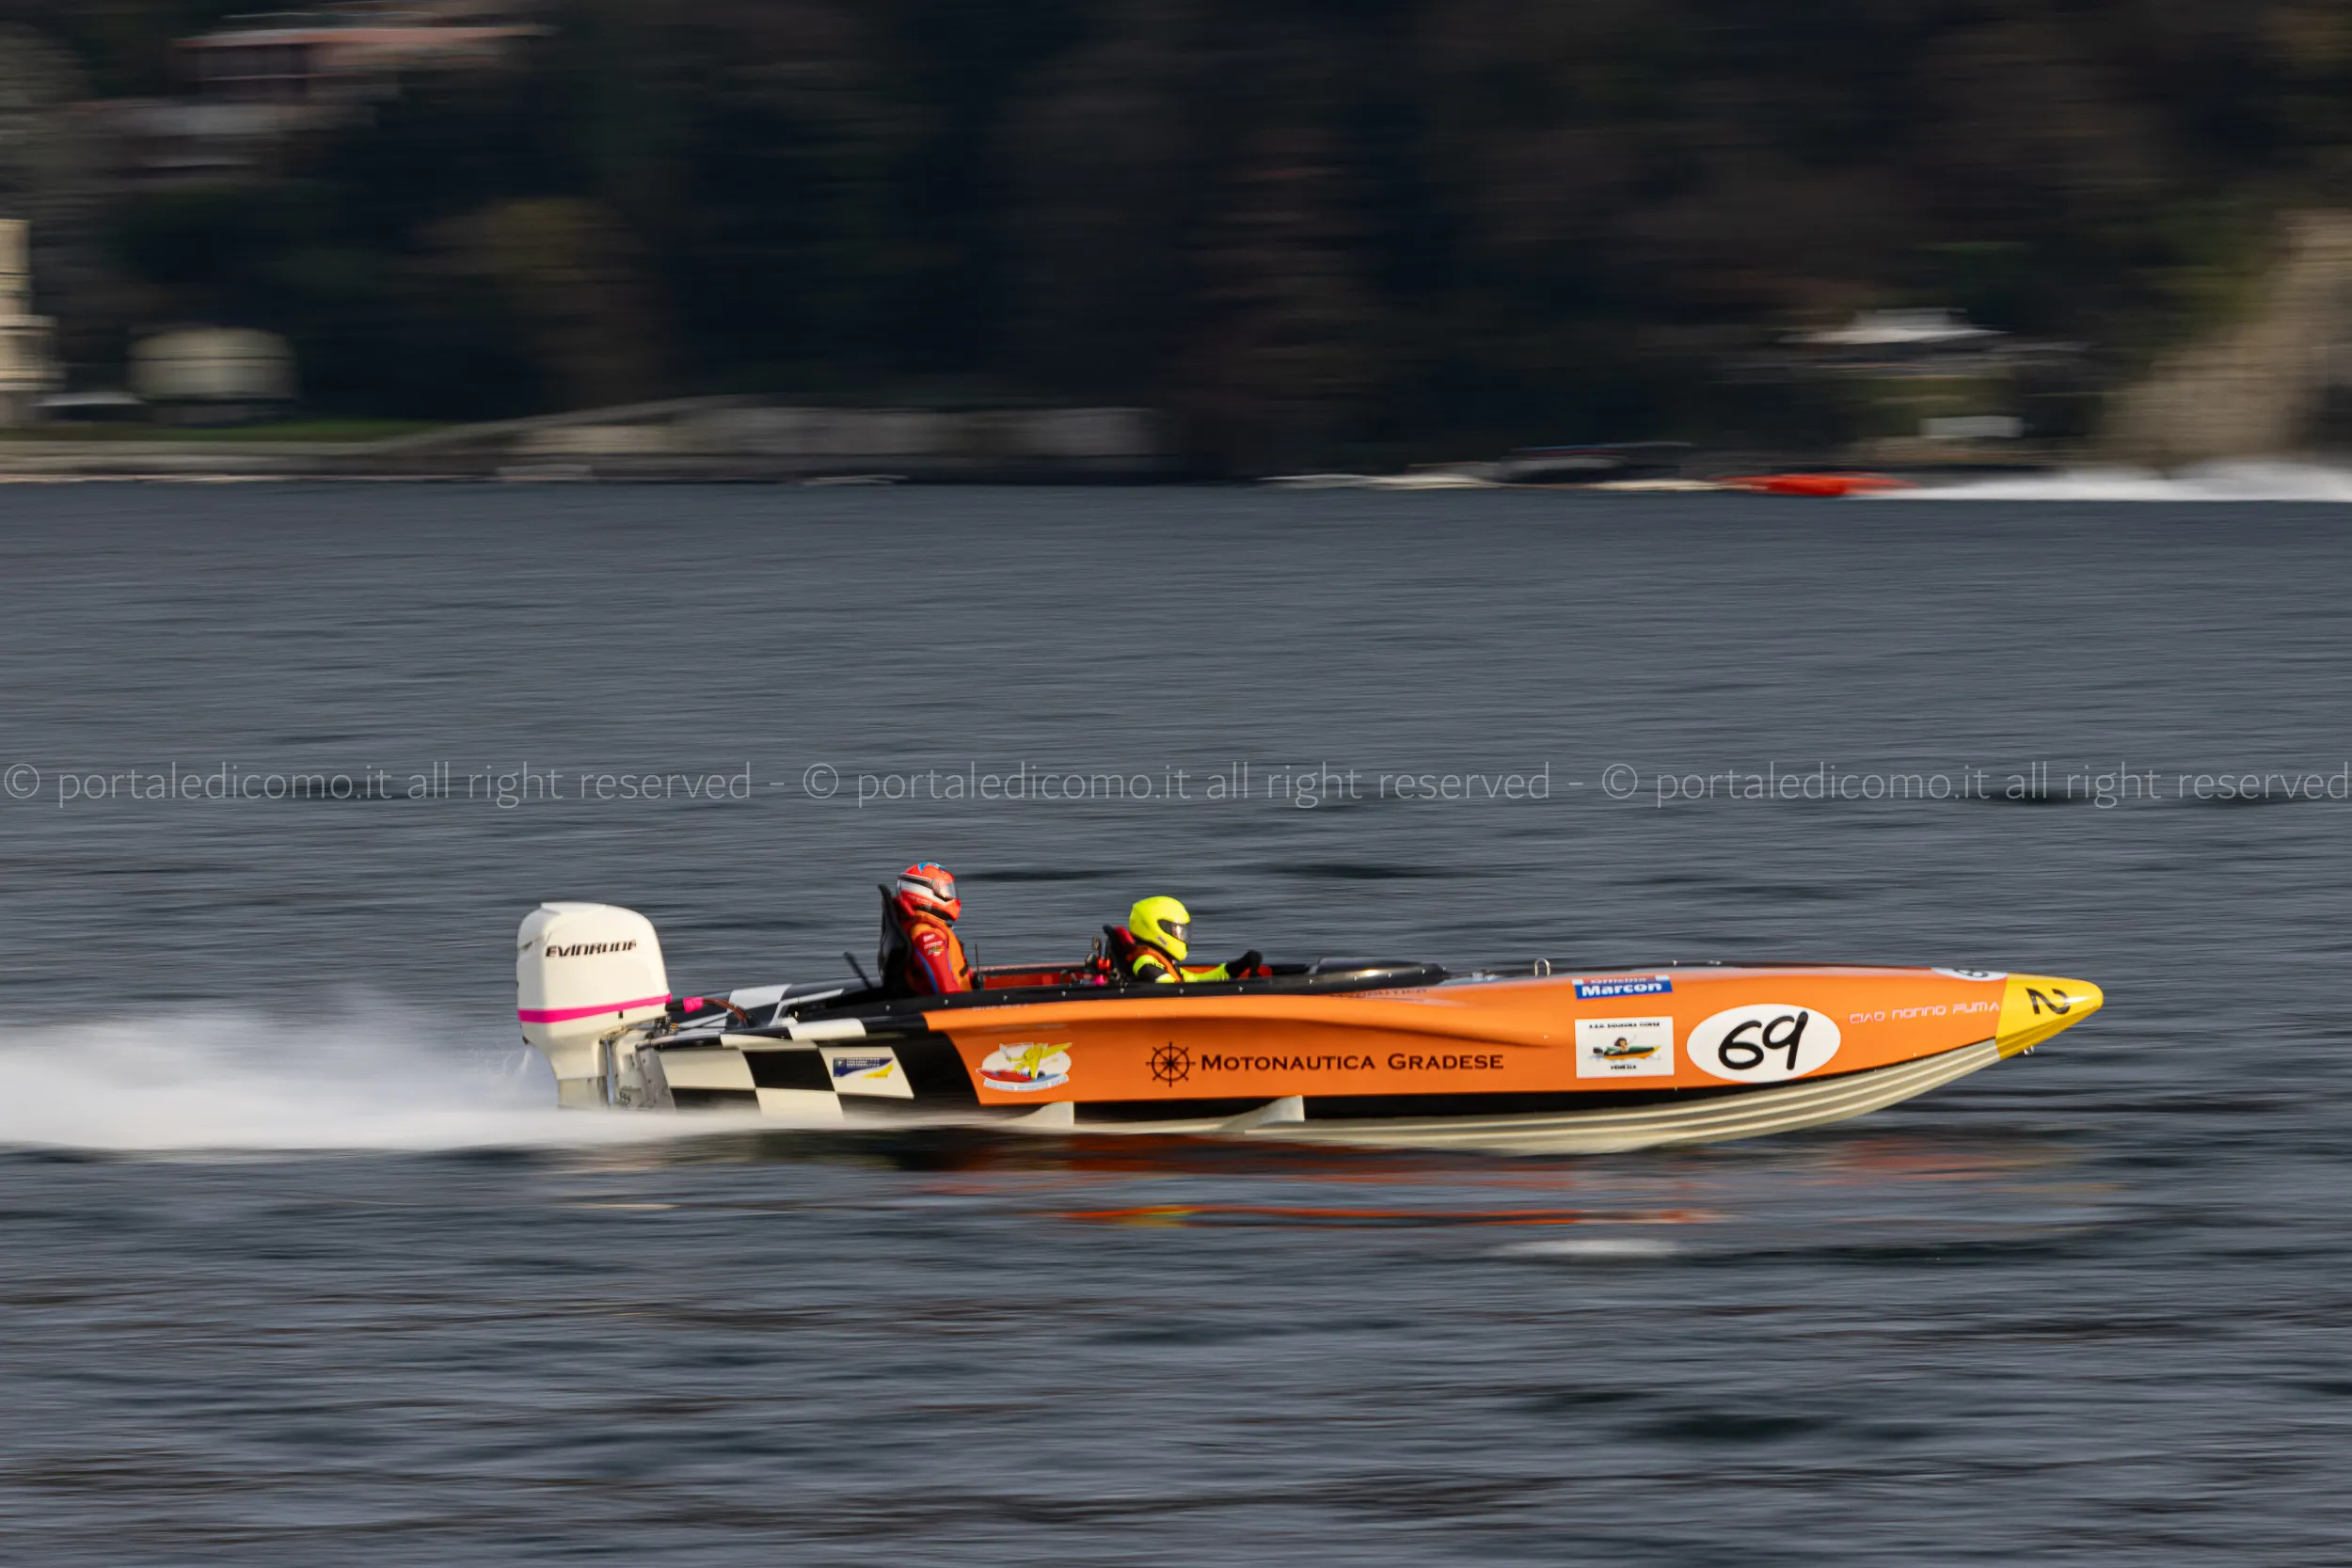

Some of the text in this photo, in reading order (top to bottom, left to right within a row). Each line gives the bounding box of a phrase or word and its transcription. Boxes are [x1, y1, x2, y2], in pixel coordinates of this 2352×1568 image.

[1581, 982, 1662, 997] Marcon
[1849, 1010, 1884, 1024] CIAO
[1718, 1011, 1808, 1070] 69
[1201, 1053, 1504, 1071] MOTONAUTICA GRADESE
